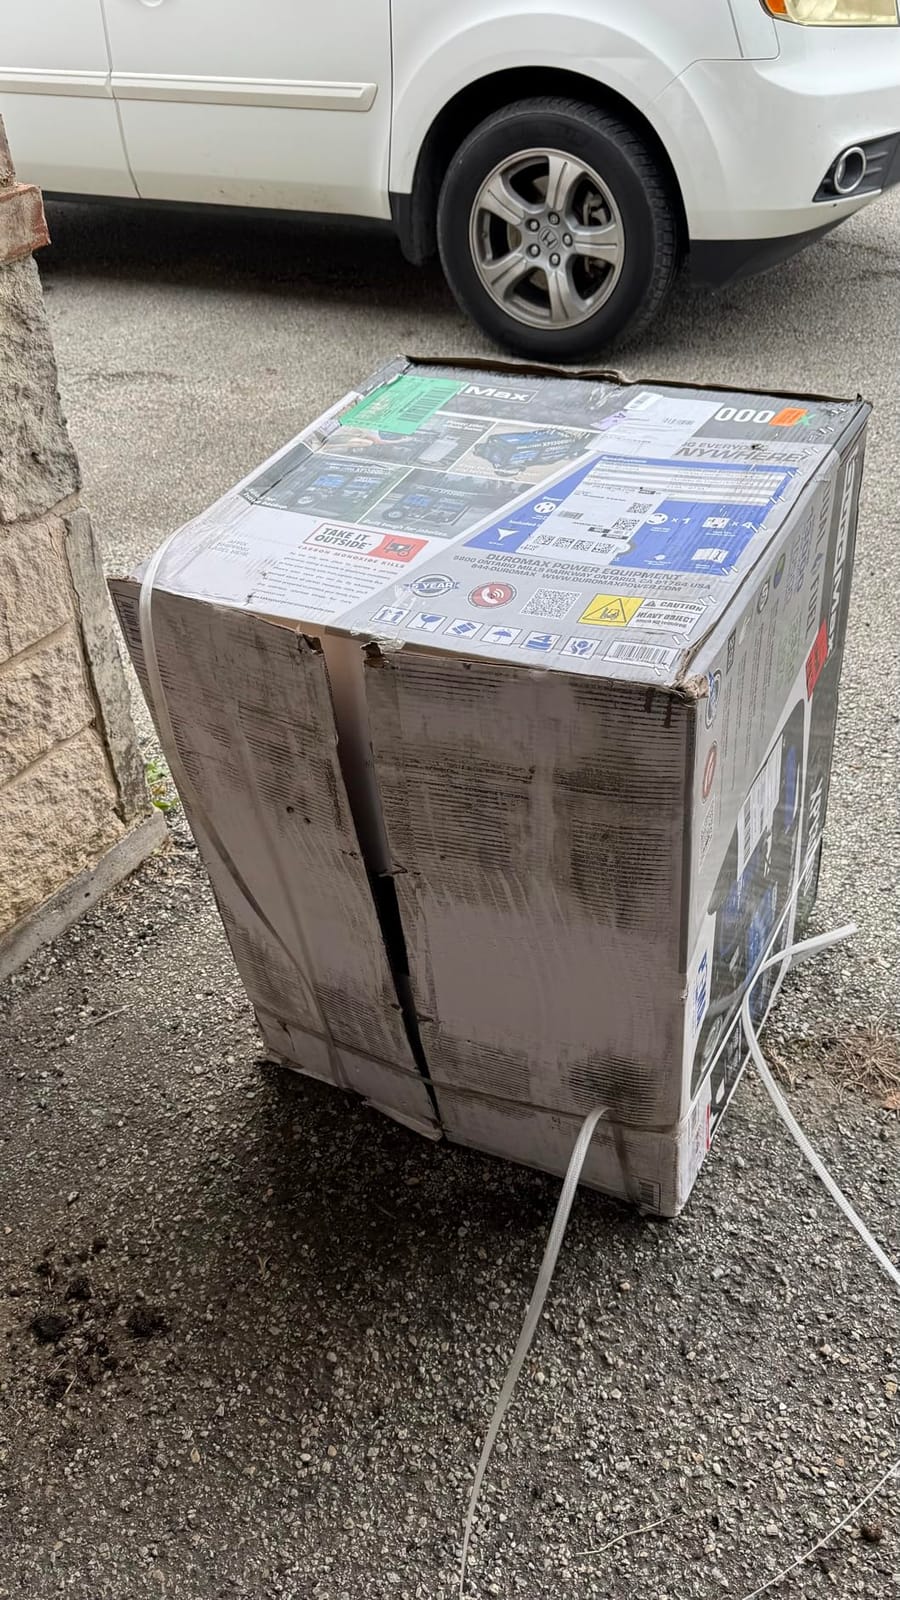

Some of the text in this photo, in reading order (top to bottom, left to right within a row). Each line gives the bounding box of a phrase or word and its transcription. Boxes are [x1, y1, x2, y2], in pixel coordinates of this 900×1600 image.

[464, 385, 529, 402] Max
[714, 407, 776, 423] 000
[674, 447, 810, 462] NYWHERE!
[321, 527, 355, 539] TAKE
[314, 535, 369, 550] OUTSIDE
[477, 558, 516, 569] ONTARIO
[516, 564, 544, 573] MILLS
[545, 568, 593, 578] PARKWAY
[486, 553, 684, 580] DUROMAX POWER EQUIPMENT
[659, 601, 704, 613] CAUTION
[636, 611, 663, 620] HEAVY
[664, 615, 695, 624] OBJECT
